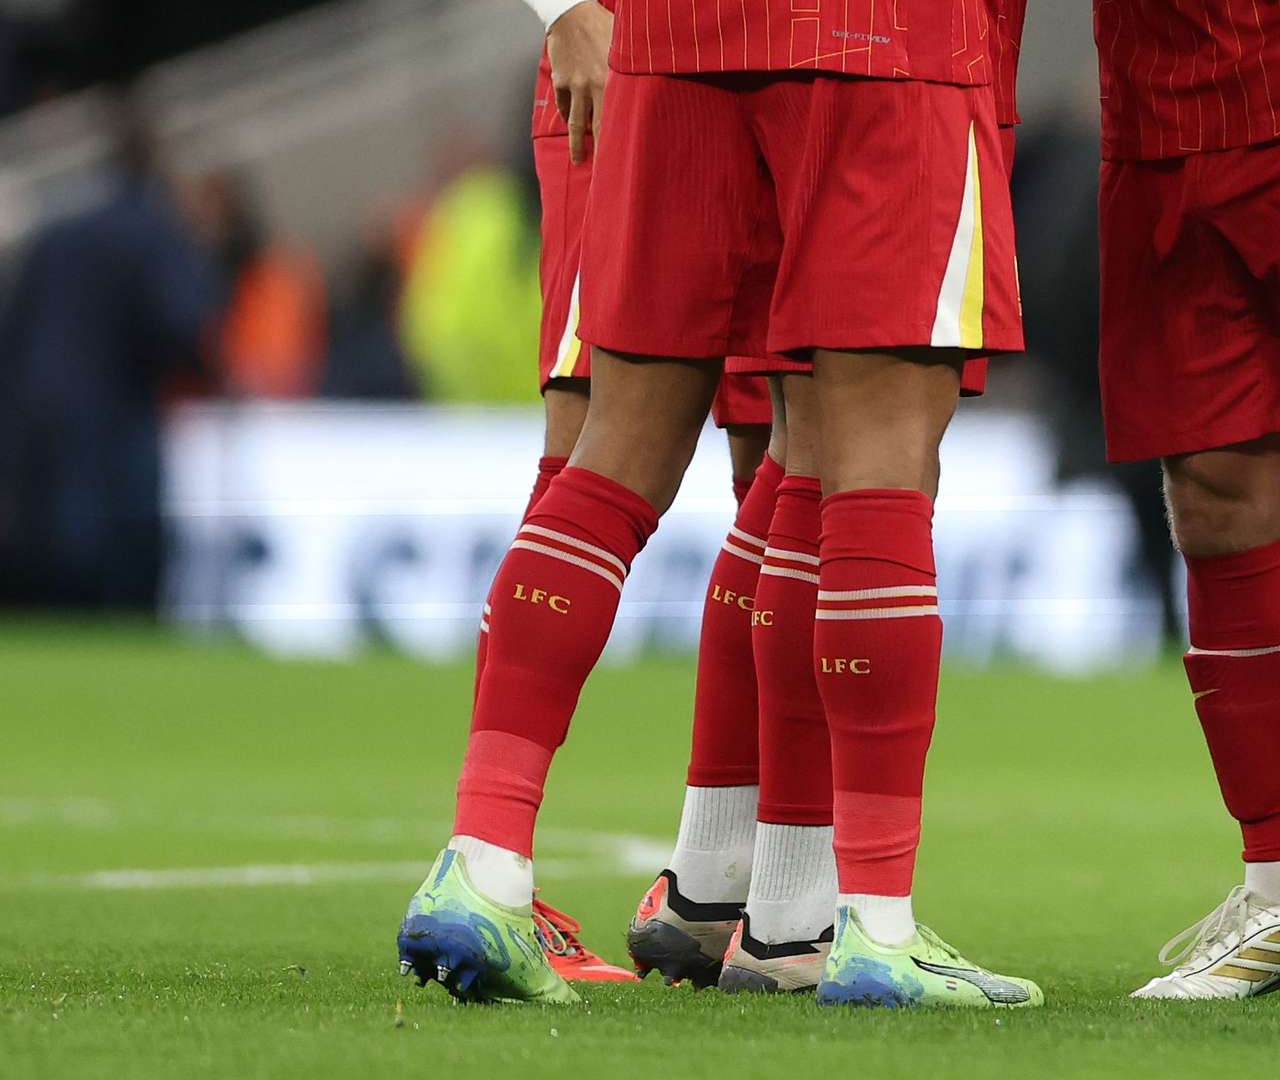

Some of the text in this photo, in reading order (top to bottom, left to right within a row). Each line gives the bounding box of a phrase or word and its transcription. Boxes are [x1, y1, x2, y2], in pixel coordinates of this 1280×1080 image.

[513, 584, 571, 614] LFC
[711, 584, 756, 611] LFC
[821, 657, 871, 674] LFC
